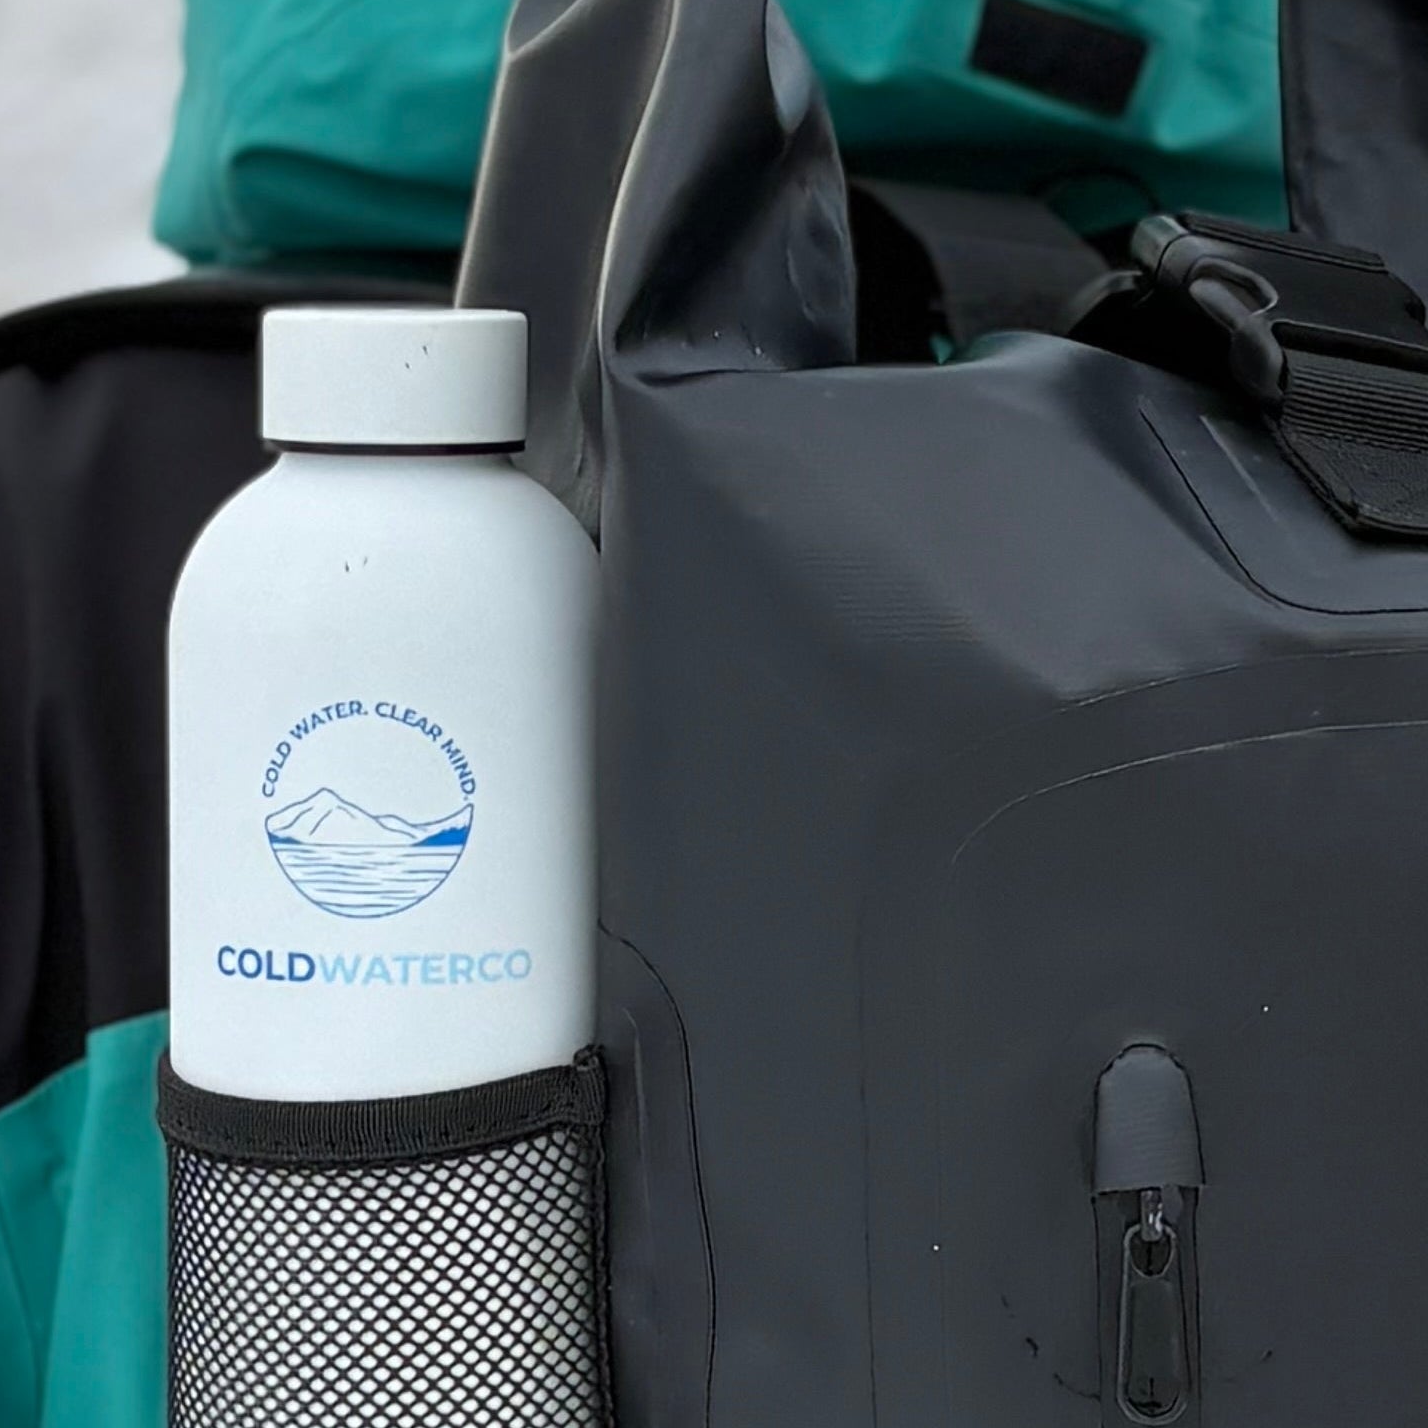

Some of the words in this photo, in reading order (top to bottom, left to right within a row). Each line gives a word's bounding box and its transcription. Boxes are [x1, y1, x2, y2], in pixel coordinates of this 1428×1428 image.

[262, 741, 292, 798] COLD
[289, 700, 369, 741] WATER.
[375, 701, 443, 742] CLEAR
[440, 738, 477, 802] MIND.
[217, 945, 533, 986] COLDWATERCO
